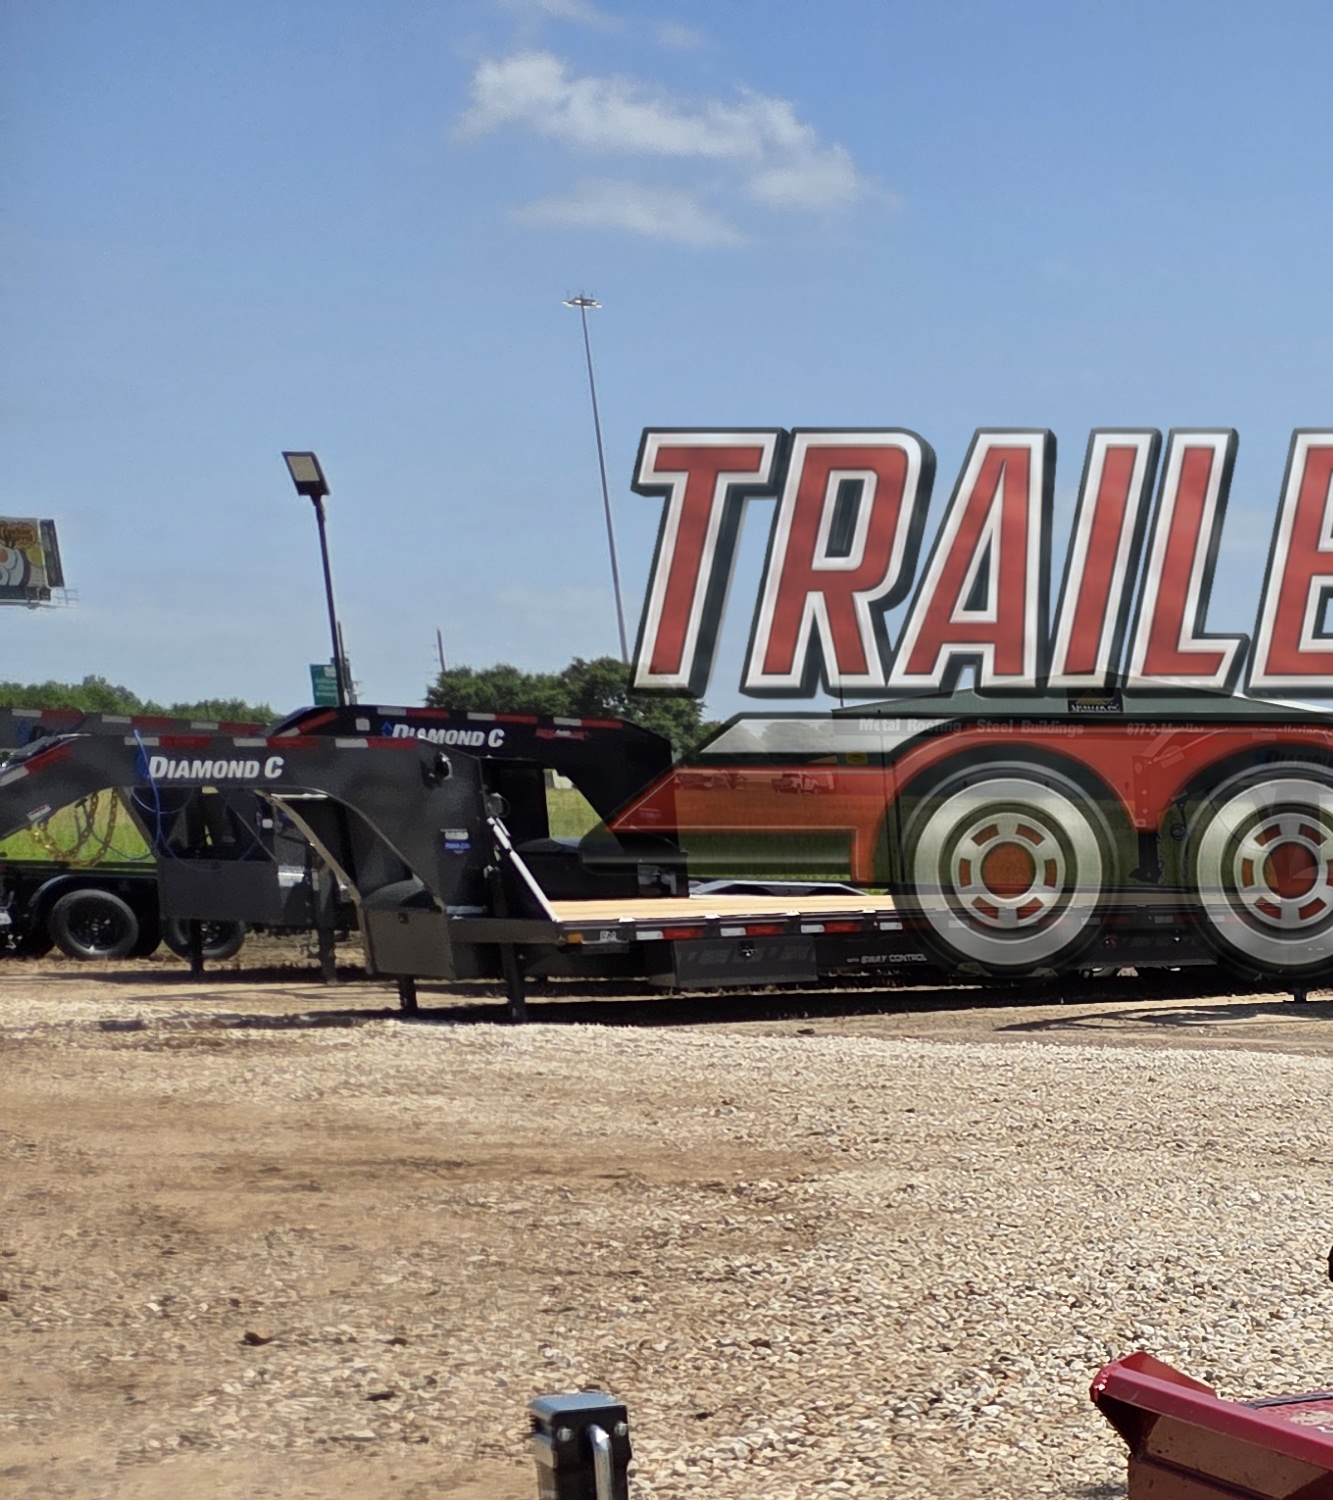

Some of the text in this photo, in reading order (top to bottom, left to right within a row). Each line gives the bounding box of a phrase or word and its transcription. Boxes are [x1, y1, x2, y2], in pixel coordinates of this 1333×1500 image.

[488, 728, 505, 748] C
[859, 719, 1085, 738] Metal Roofing Steel Buildings
[149, 755, 285, 779] DIAMOND C
